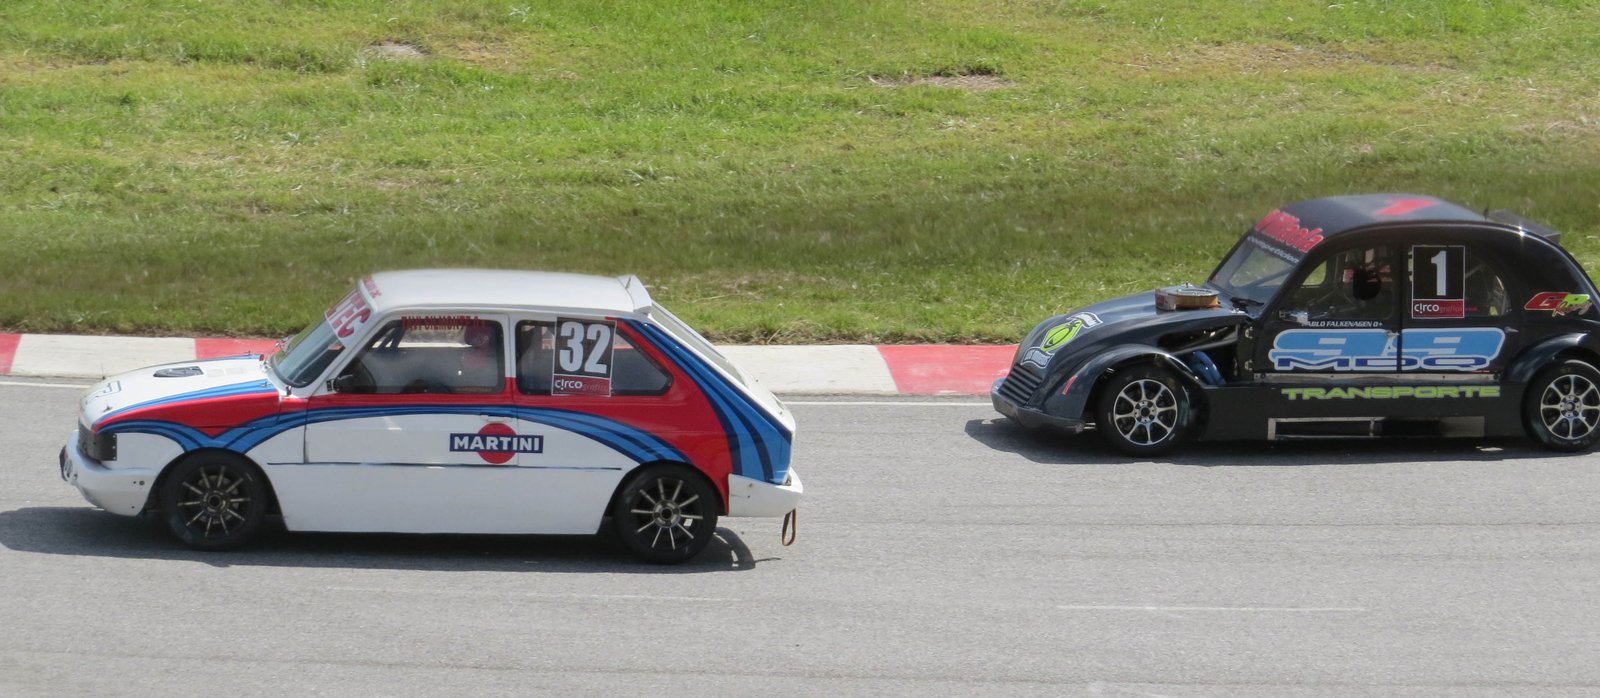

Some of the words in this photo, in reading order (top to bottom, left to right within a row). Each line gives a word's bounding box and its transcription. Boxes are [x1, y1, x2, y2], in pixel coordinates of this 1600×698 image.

[1431, 250, 1447, 296] 1
[559, 321, 611, 374] 32
[1280, 385, 1501, 400] TRANSPORTE
[453, 435, 540, 451] MARTINI
